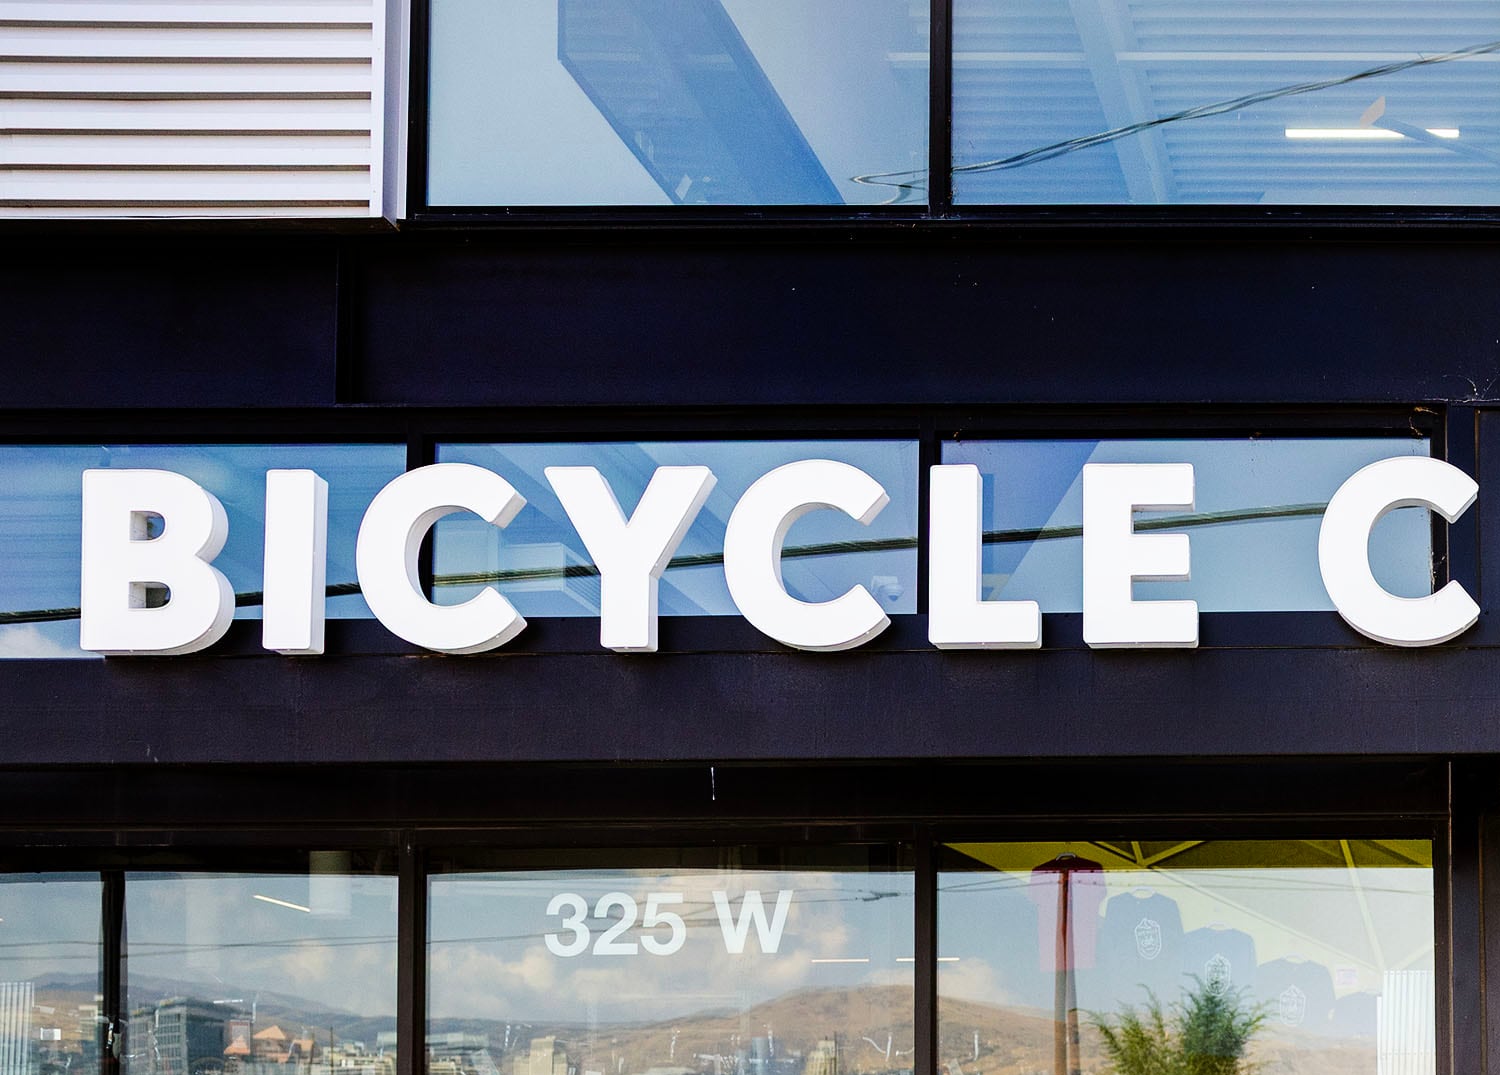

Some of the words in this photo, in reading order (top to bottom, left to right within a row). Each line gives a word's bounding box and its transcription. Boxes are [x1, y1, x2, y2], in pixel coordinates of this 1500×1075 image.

[80, 457, 1200, 656] BICYCLE
[544, 891, 687, 957] 325
[712, 889, 794, 954] W
